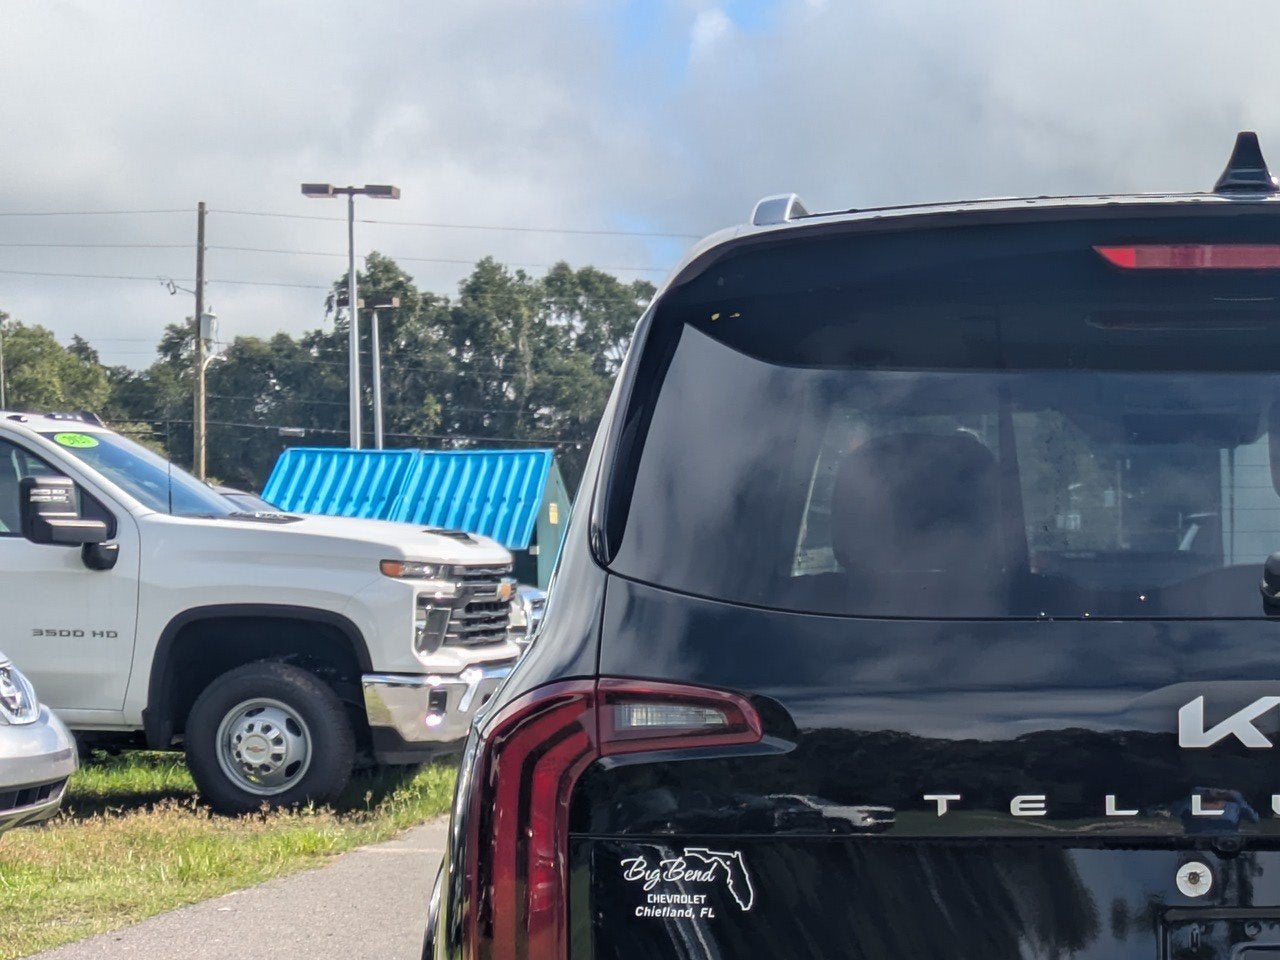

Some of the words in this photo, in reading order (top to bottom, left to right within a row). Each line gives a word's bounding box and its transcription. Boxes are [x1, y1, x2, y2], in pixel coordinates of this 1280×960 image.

[31, 628, 85, 638] 3500
[91, 630, 119, 639] HD
[620, 855, 661, 892] Big
[659, 856, 718, 883] Bend
[647, 893, 707, 905] CHEVROLET
[635, 905, 696, 920] Chiefland,
[699, 907, 716, 919] FL
